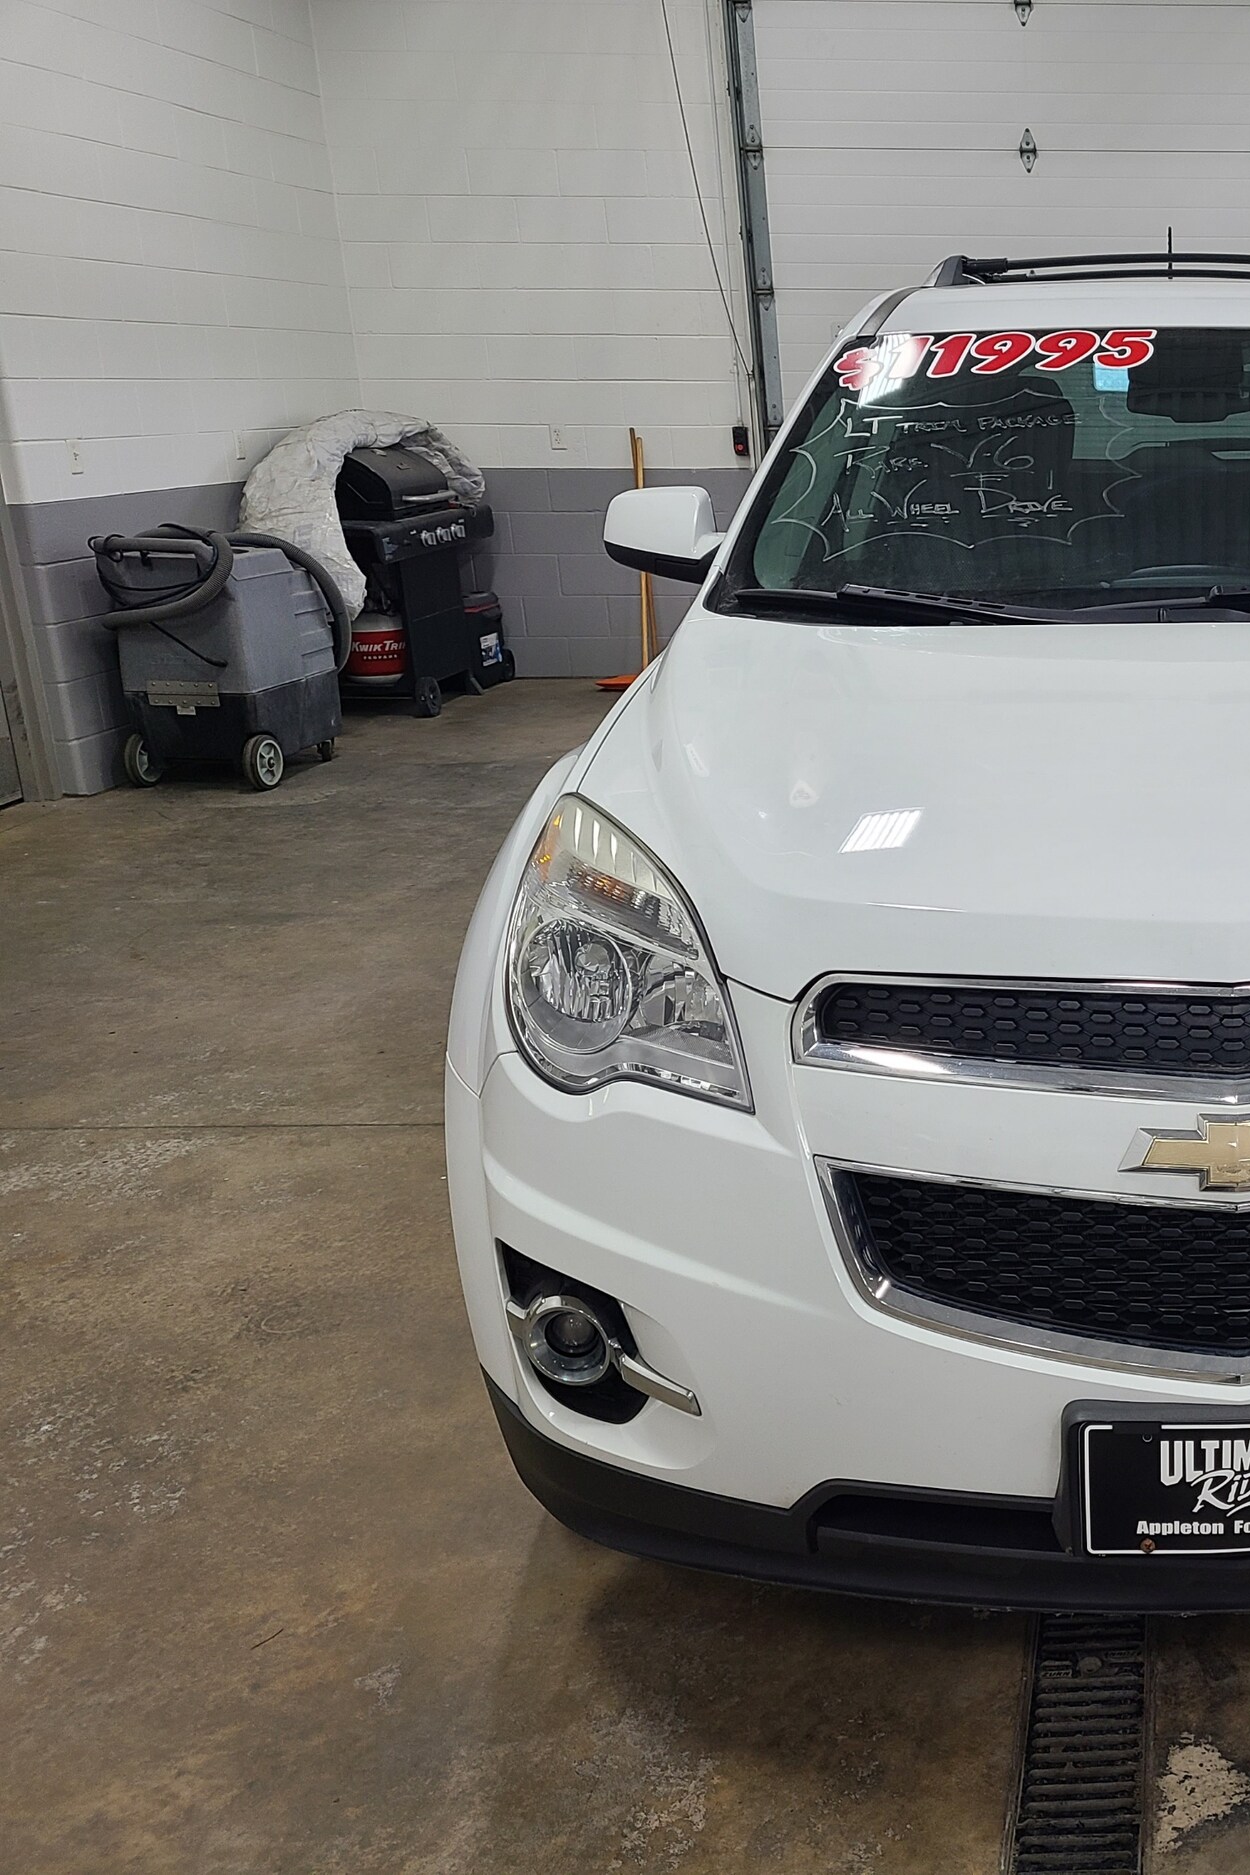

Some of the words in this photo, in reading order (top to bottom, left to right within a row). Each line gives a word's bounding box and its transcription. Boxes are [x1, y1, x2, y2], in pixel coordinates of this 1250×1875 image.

[833, 330, 1157, 391] $11995
[844, 416, 903, 438] LT
[977, 413, 1082, 431] PACKAGE
[820, 493, 878, 533] ALL
[870, 479, 960, 520] WHEEL
[1136, 1519, 1225, 1536] Appleton
